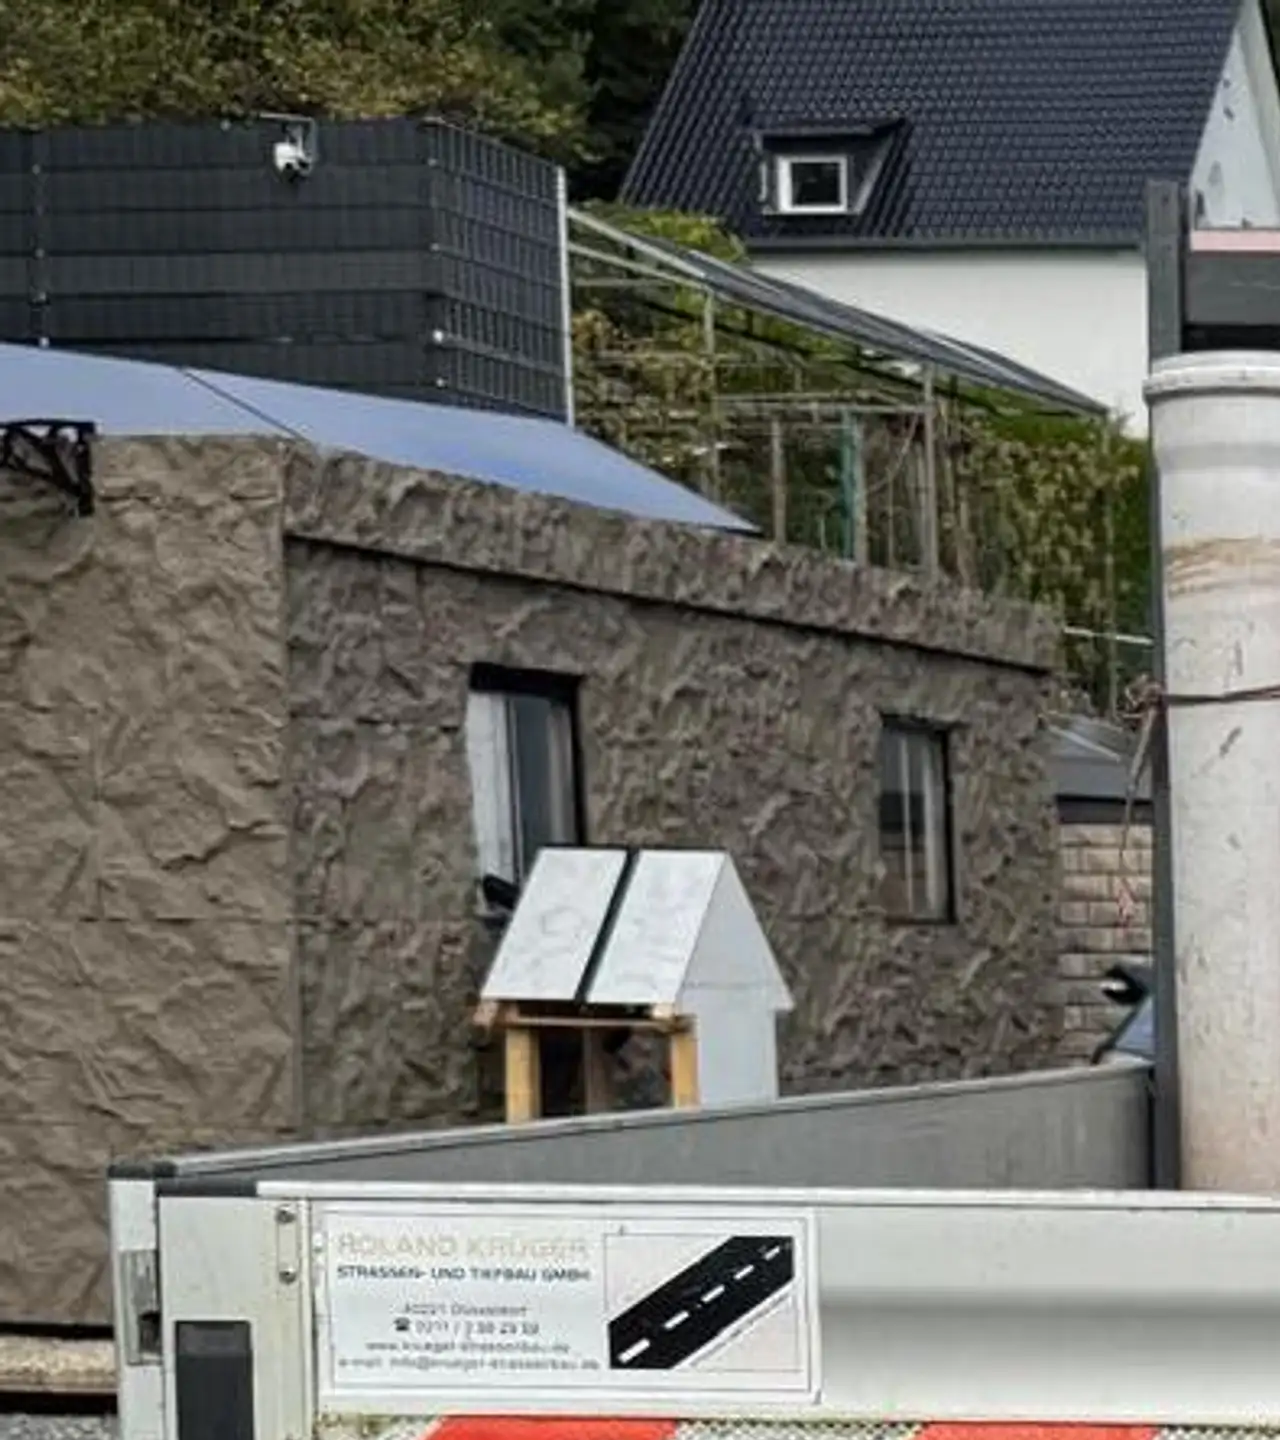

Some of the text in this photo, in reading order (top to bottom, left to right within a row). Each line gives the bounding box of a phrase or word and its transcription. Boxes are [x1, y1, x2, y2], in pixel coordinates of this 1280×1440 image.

[338, 1232, 458, 1256] ROLAND
[337, 1265, 426, 1279] STRASSEN-
[431, 1267, 465, 1280] UND
[470, 1267, 536, 1281] TIEFBAU
